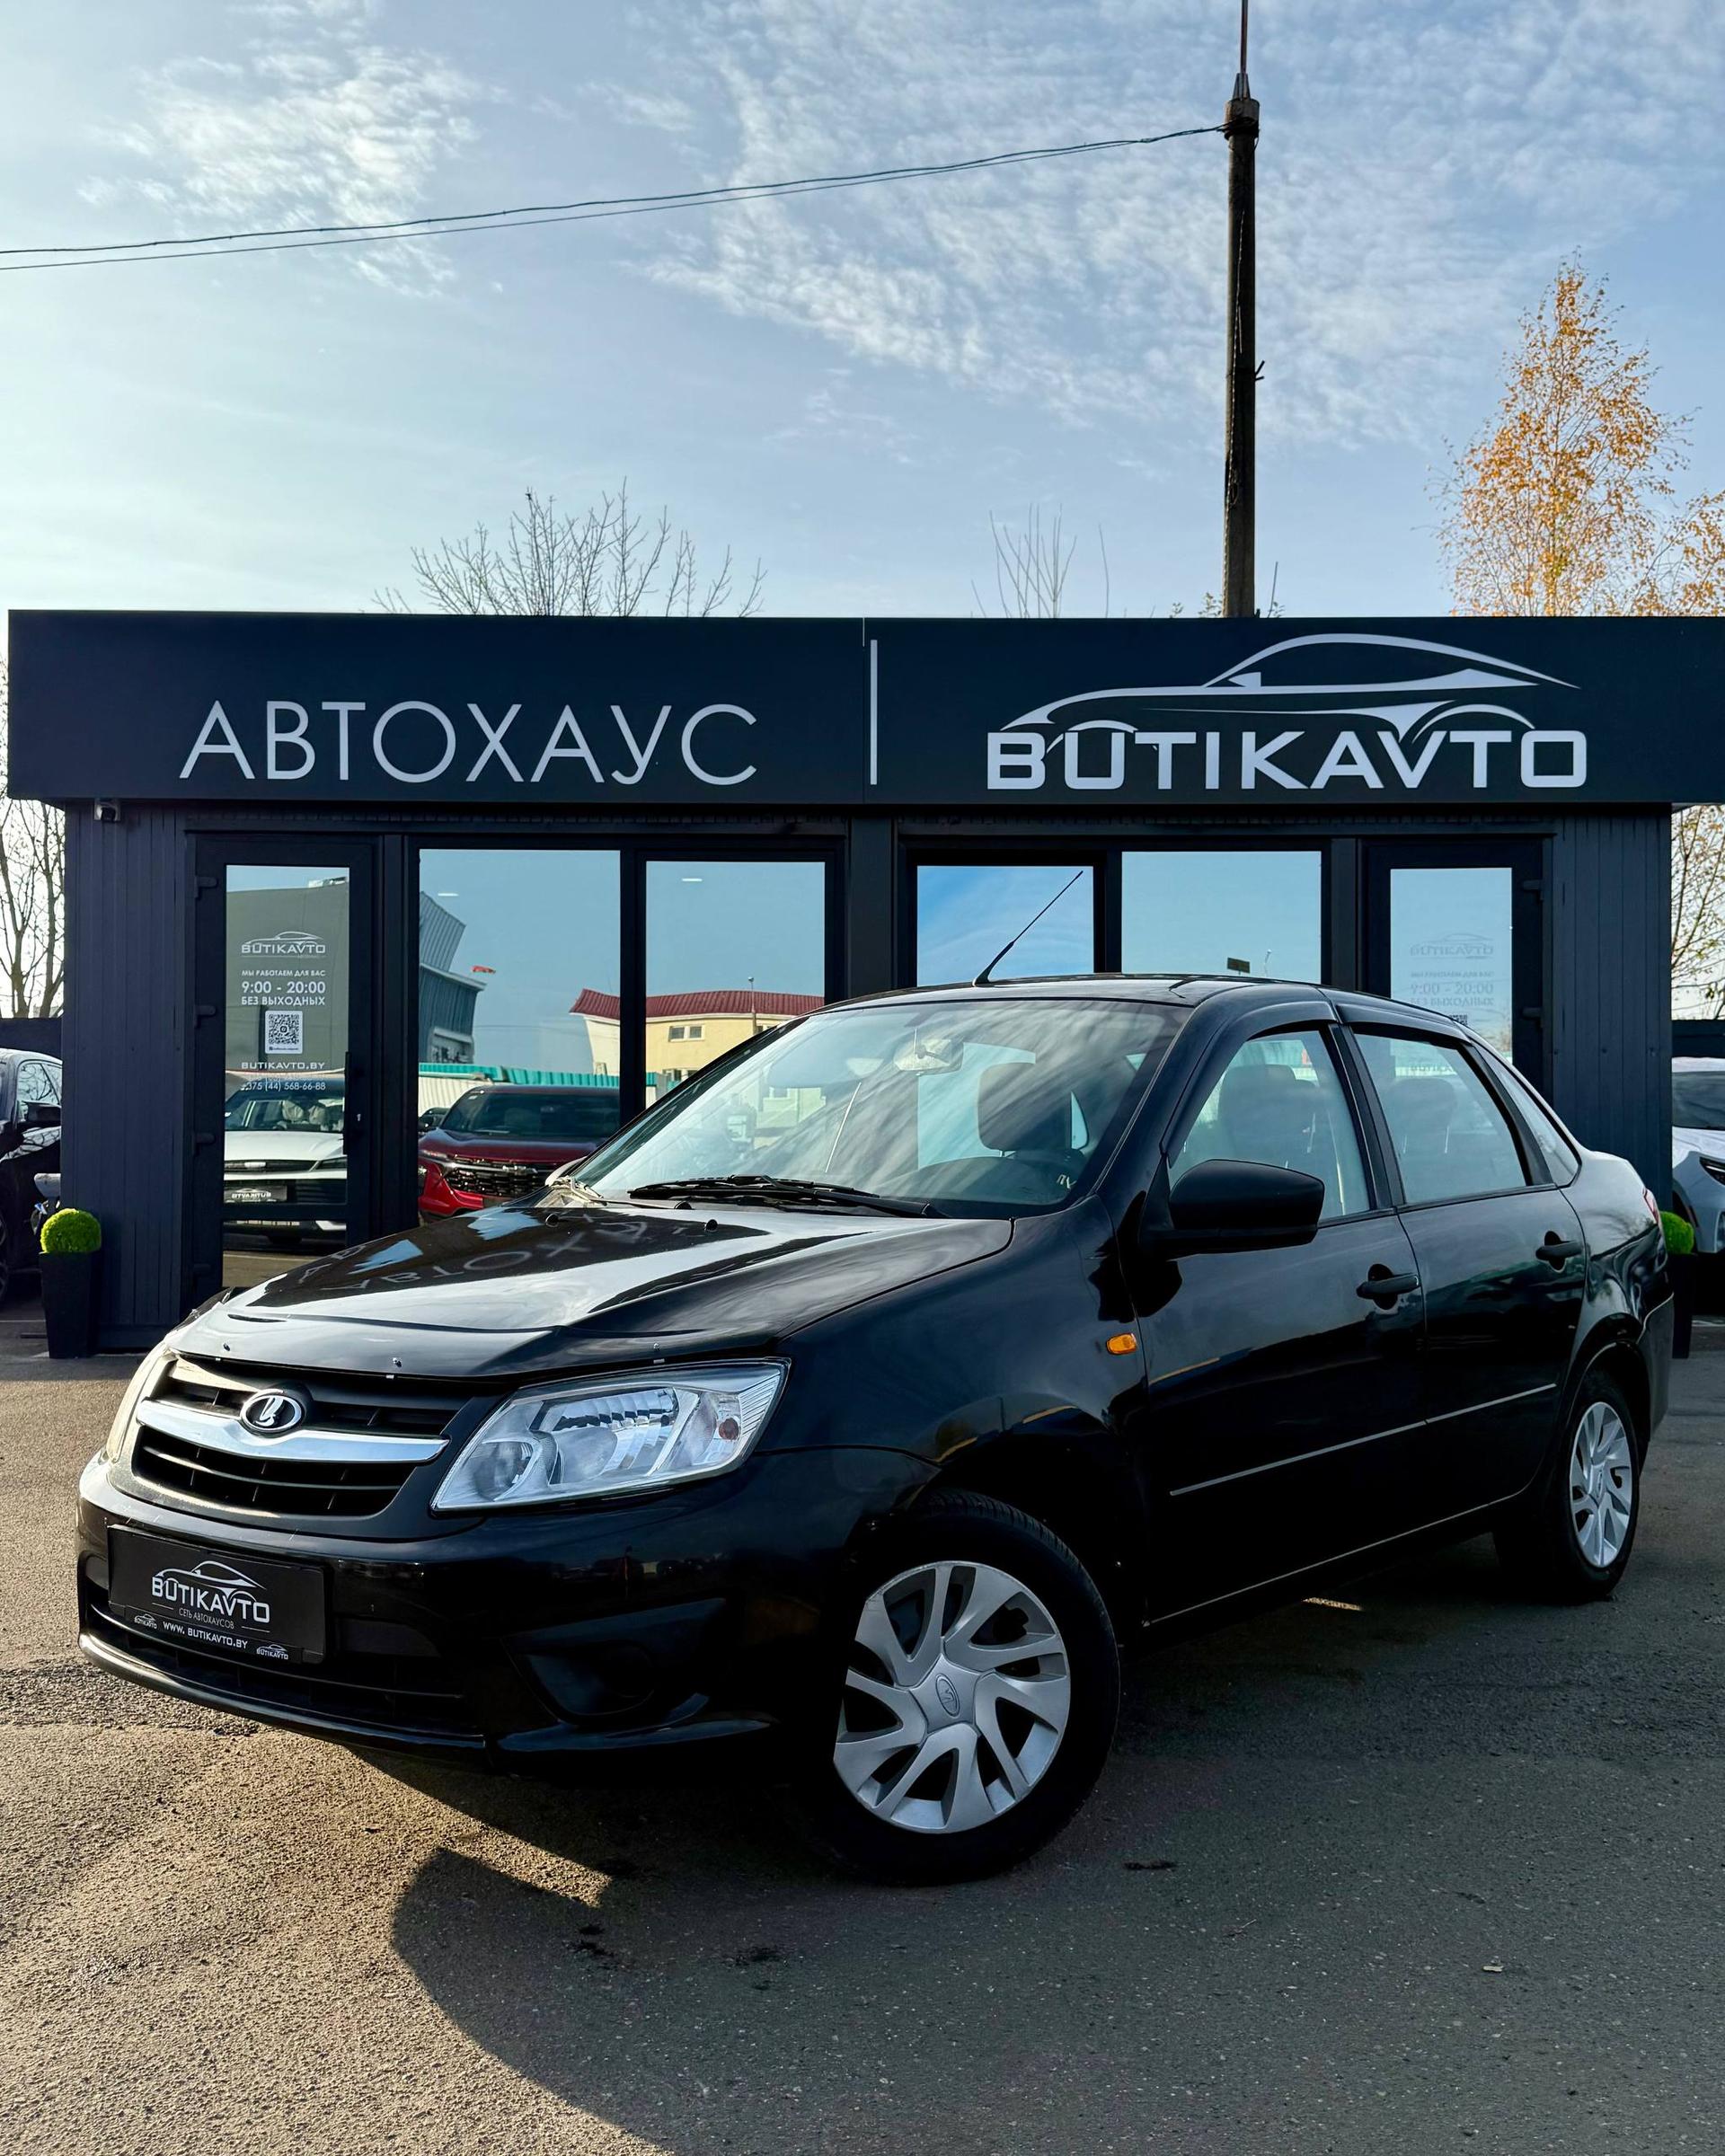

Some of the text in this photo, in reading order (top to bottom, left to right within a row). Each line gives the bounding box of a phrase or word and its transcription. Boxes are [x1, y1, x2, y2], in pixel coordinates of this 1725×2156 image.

[180, 700, 756, 785] АВТОХАУС
[987, 729, 1587, 789] BUTIKAVTO
[242, 943, 325, 953] BUTIKAVTO
[242, 981, 271, 994] 9:00
[287, 981, 325, 994] 20:00
[242, 996, 325, 1006] БЕЗ ВЫХОДНЫХ
[241, 1062, 325, 1070] BUTIKAVTO.BY
[265, 1080, 281, 1091] (44)
[284, 1082, 326, 1091] 568-66-88
[152, 1577, 270, 1623] BUTIKAVTO
[179, 1608, 234, 1630] СЕТЬ АВТОХАУСОВ
